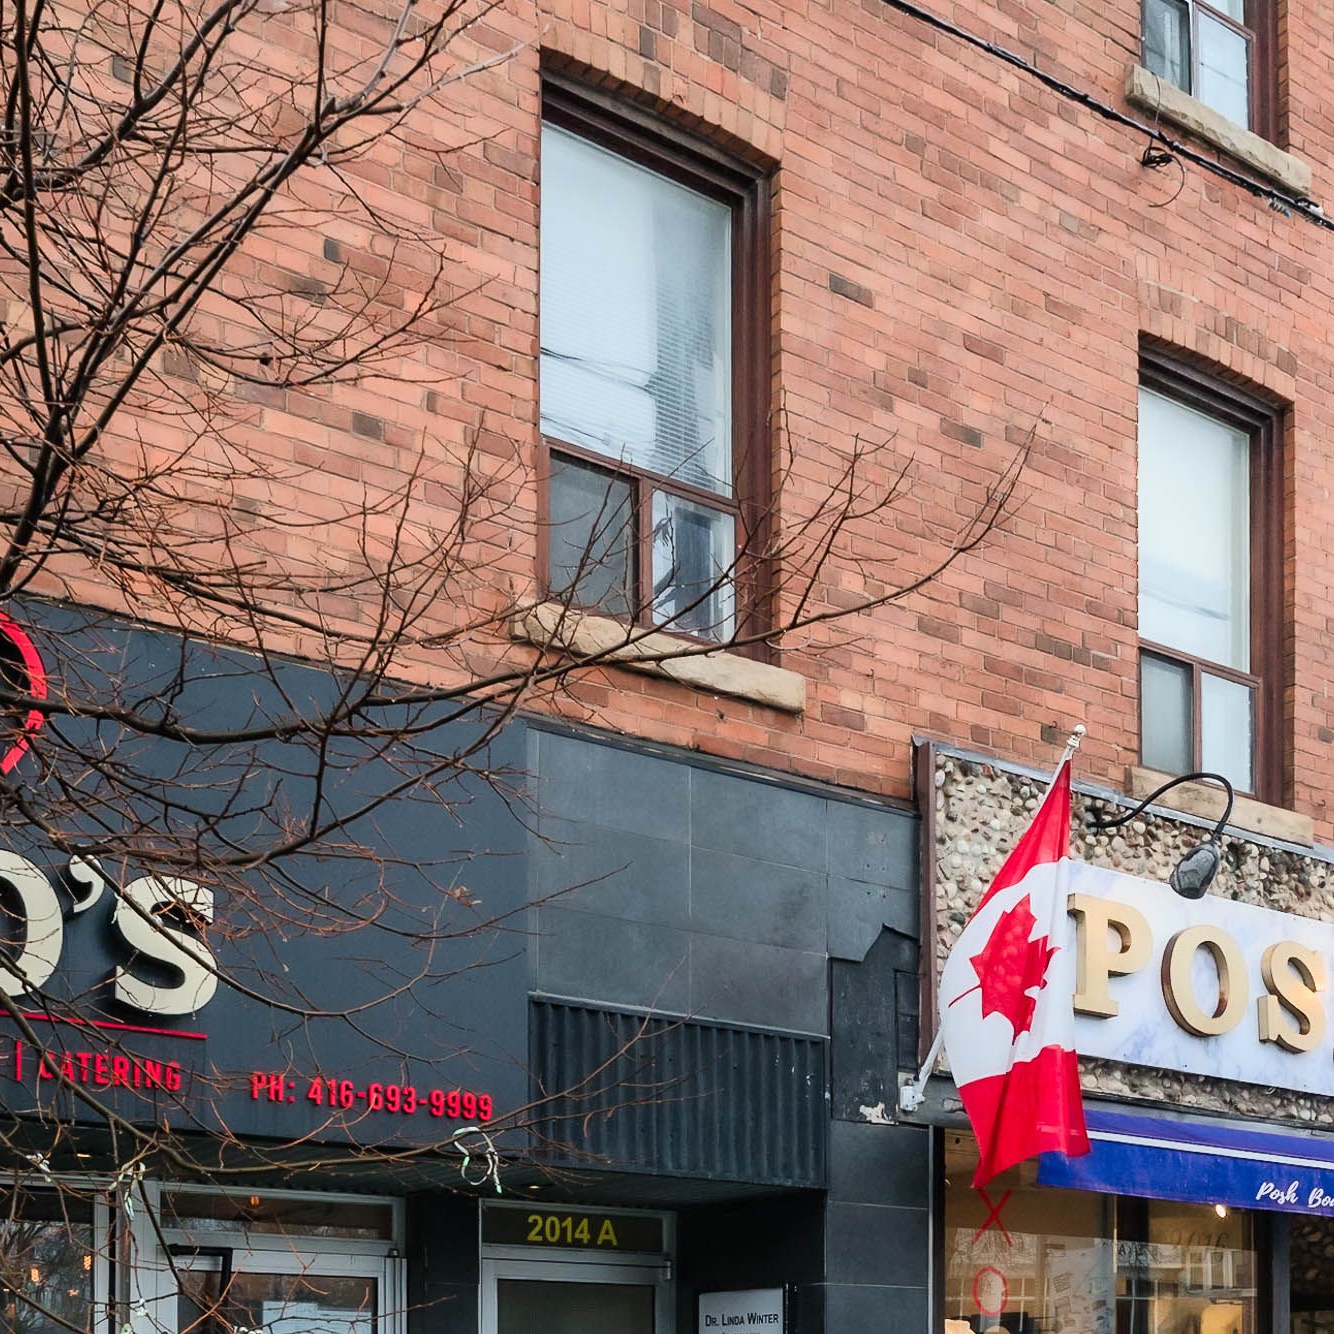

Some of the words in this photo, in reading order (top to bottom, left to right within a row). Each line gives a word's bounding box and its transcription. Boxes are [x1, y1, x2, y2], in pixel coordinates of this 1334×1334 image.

[251, 1071, 295, 1103] PH:
[307, 1076, 493, 1121] 416-693-9999
[1256, 1180, 1299, 1204] Posh
[527, 1214, 591, 1244] 2014
[597, 1219, 618, 1246] A
